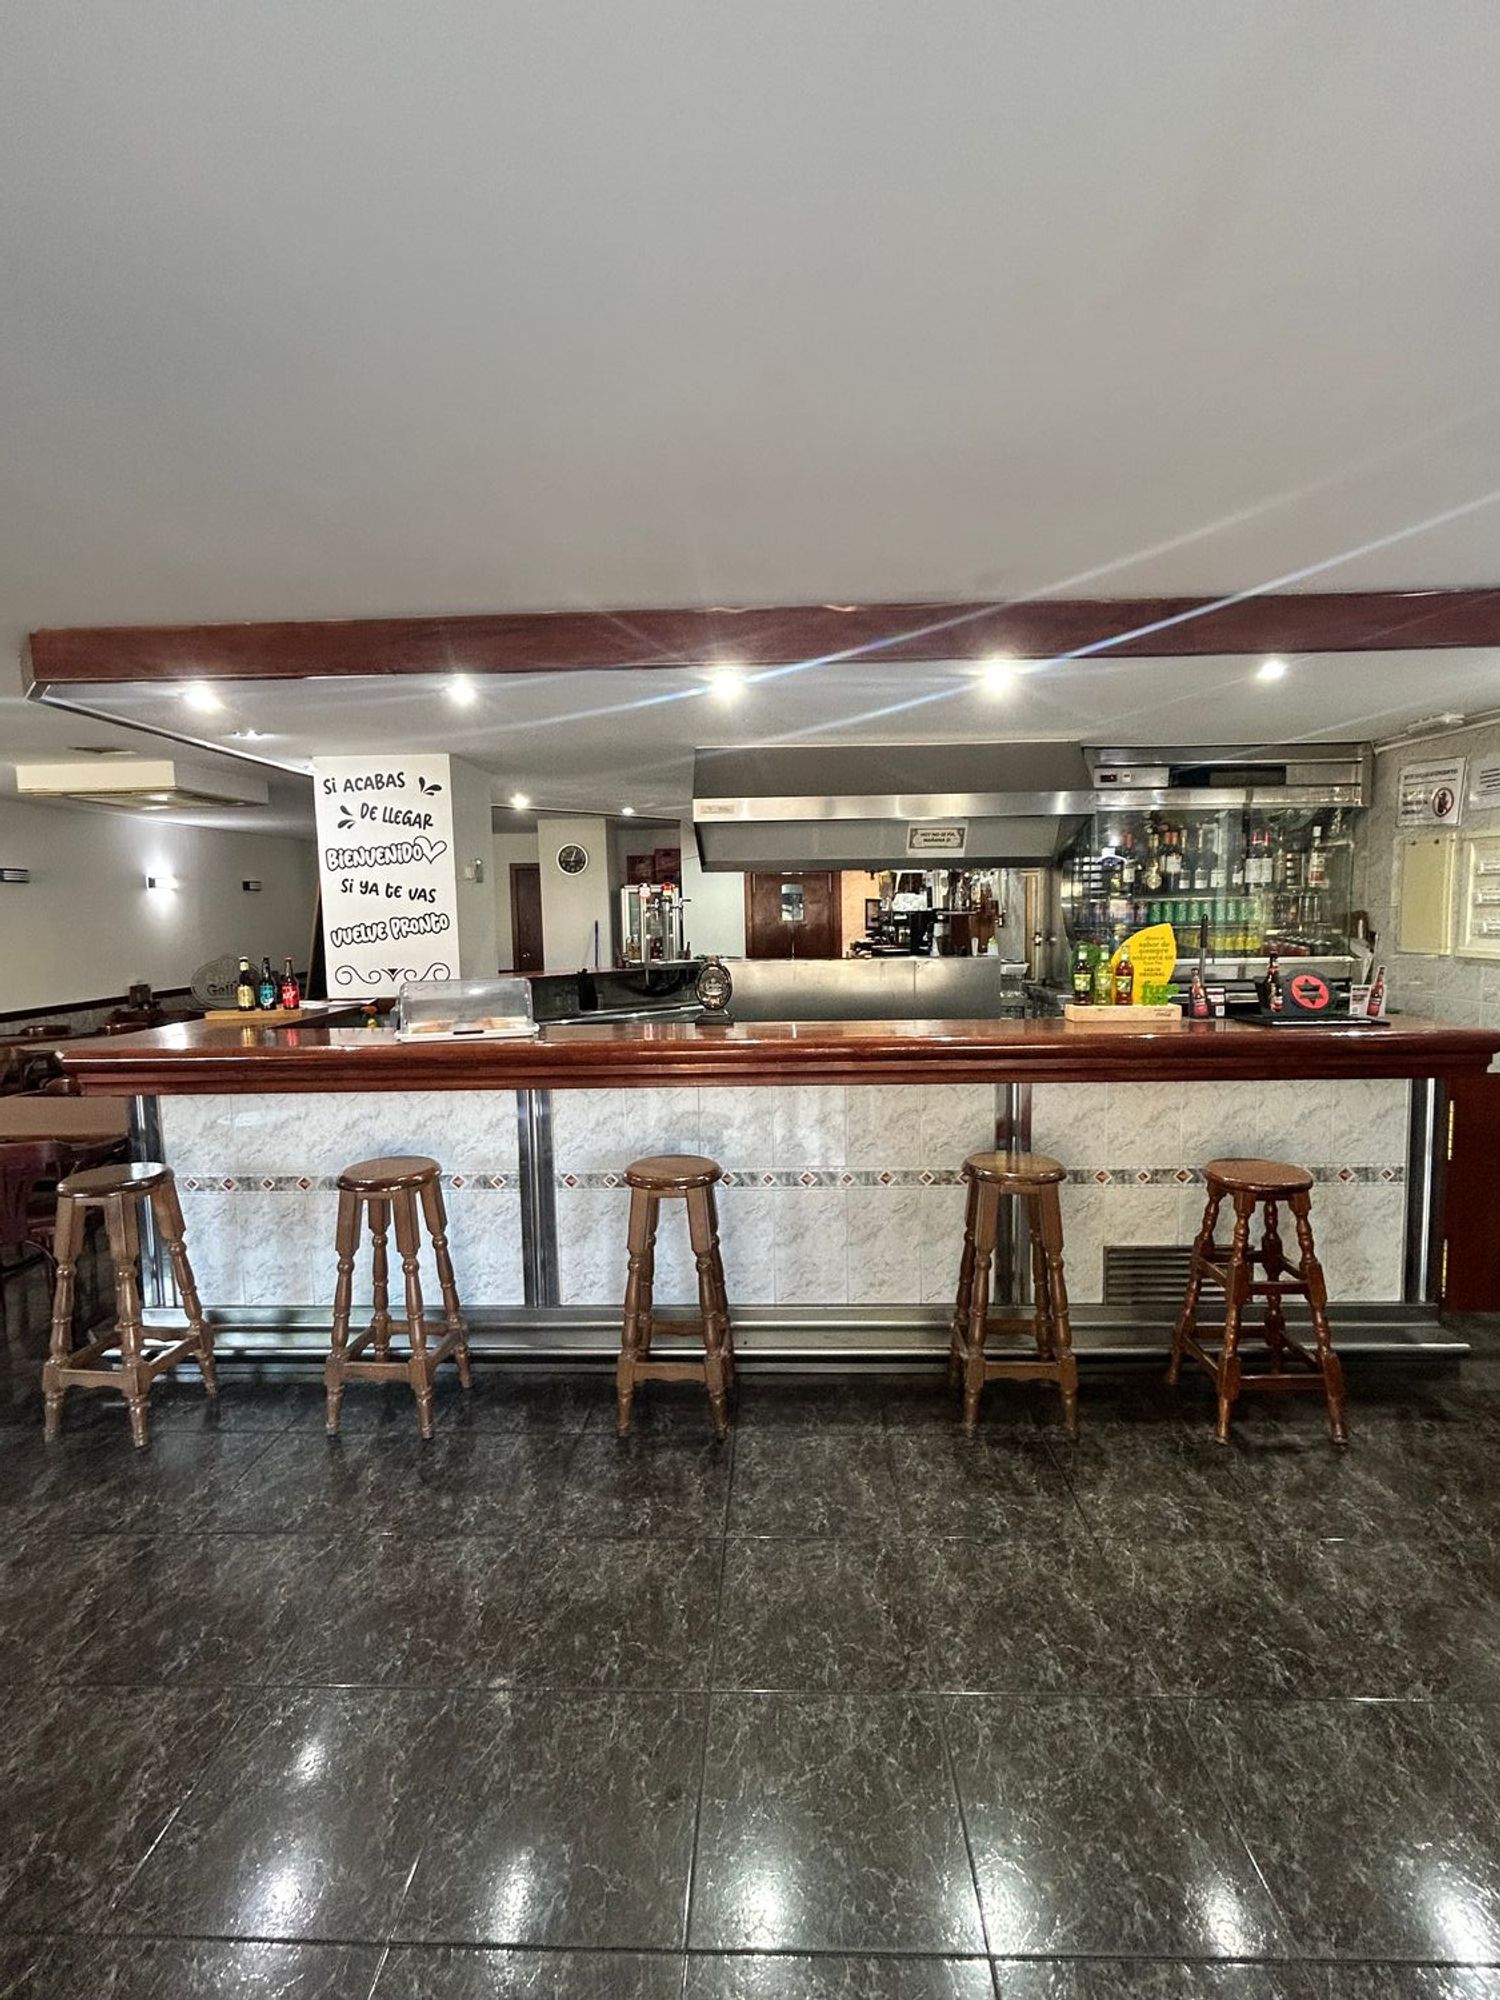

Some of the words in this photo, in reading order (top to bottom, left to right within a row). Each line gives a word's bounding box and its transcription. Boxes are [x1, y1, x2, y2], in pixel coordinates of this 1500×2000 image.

[343, 771, 406, 793] ACABAS
[359, 802, 378, 821] DE
[382, 806, 434, 830] LLEGAR
[359, 880, 379, 897] YA
[408, 887, 437, 903] VAS
[330, 921, 387, 947] VUELVE
